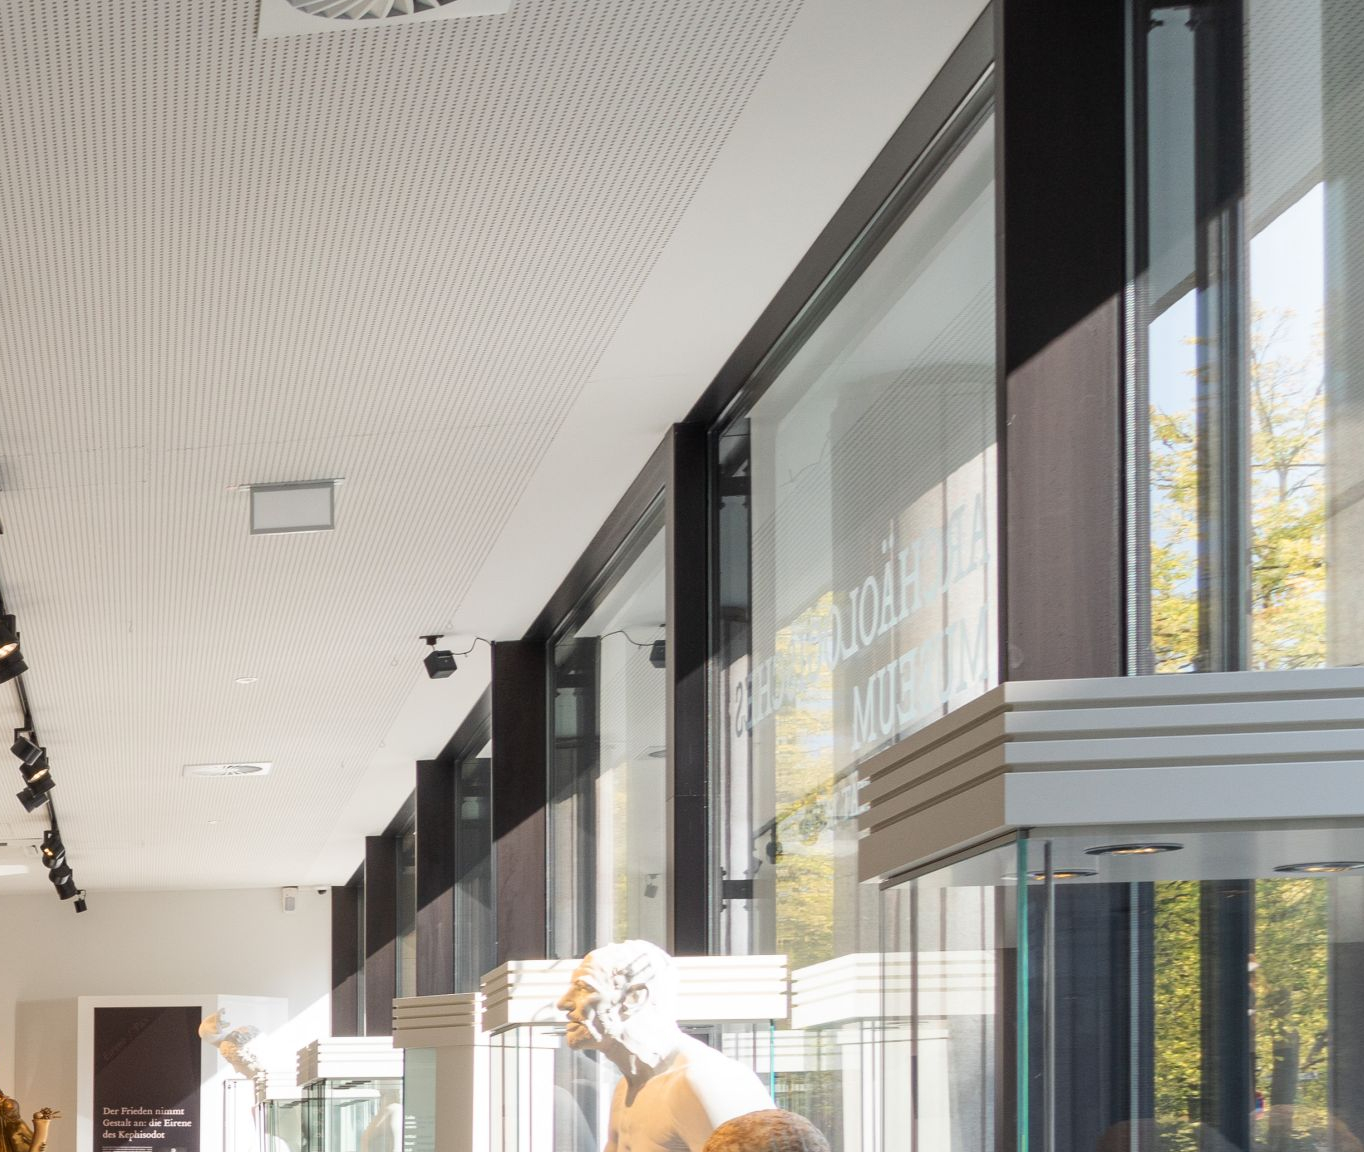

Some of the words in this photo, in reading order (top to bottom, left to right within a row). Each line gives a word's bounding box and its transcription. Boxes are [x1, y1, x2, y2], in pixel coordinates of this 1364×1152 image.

[103, 1107, 120, 1116] Der
[121, 1106, 153, 1116] Frieden
[154, 1107, 185, 1116] nimmt
[102, 1118, 132, 1128] Gestalt
[149, 1118, 162, 1127] die
[163, 1118, 192, 1127] Eirene
[102, 1130, 117, 1139] des
[118, 1130, 165, 1142] Kephisodot
